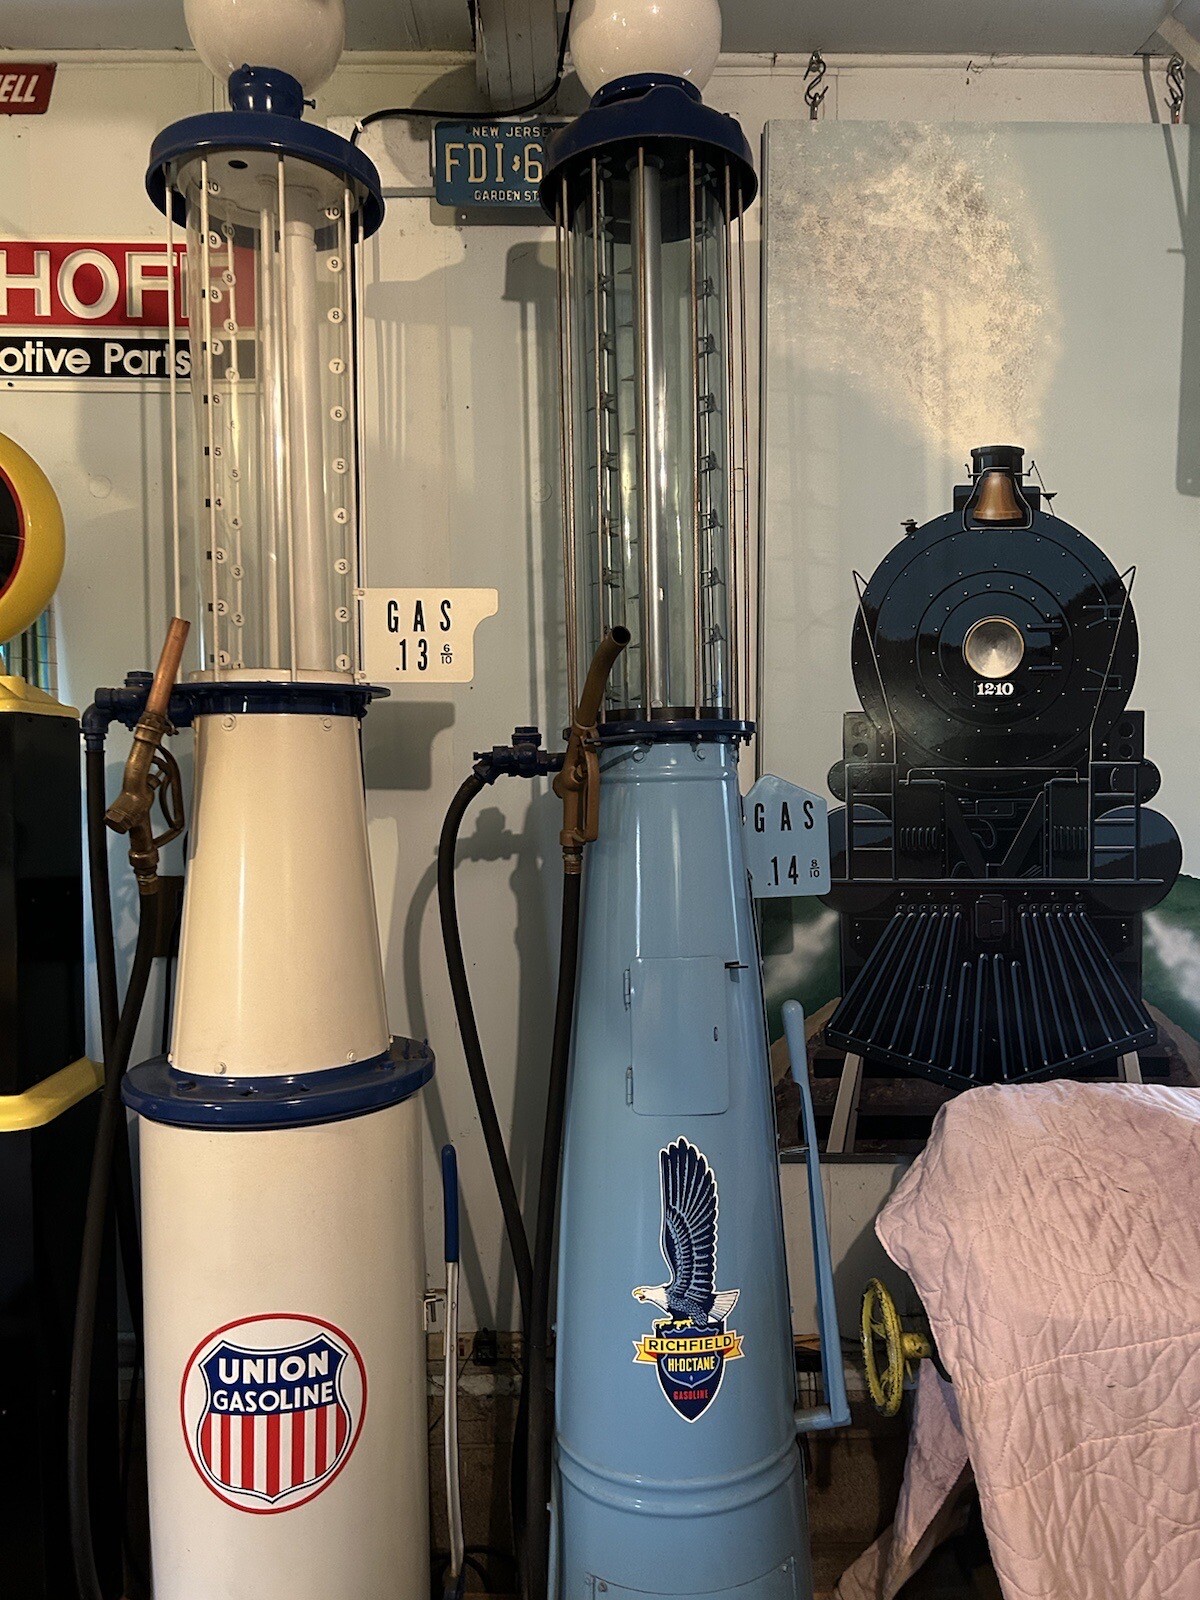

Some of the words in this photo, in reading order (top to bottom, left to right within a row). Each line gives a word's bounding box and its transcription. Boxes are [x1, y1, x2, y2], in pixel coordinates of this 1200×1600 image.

[0, 74, 40, 103] ELL
[472, 126, 499, 137] NEW
[474, 190, 520, 201] GARDEN
[327, 207, 340, 216] 10
[210, 235, 217, 245] 9
[331, 260, 338, 269] 9
[226, 274, 233, 283] 9
[211, 290, 219, 299] 8
[332, 311, 340, 320] 8
[228, 322, 235, 331] 8
[213, 343, 219, 352] 7
[333, 362, 340, 371] 7
[229, 371, 236, 380] 7
[213, 395, 220, 404] 6
[334, 409, 342, 418] 6
[214, 448, 222, 456] 5
[337, 461, 344, 470] 5
[232, 469, 239, 478] 5
[215, 499, 222, 507] 4
[337, 512, 345, 520] 4
[232, 518, 239, 526] 4
[216, 551, 223, 560] 3
[339, 562, 346, 571] 3
[234, 567, 241, 576] 3
[217, 603, 225, 612] 2
[236, 614, 242, 623] 2
[340, 610, 347, 618] 2
[387, 599, 452, 633] GAS
[340, 658, 346, 667] 1
[754, 800, 814, 833] GAS
[648, 1335, 733, 1351] RICHFIELD
[218, 1350, 329, 1385] UNION
[213, 1380, 334, 1413] GASOLINE
[673, 1389, 709, 1401] GASOLINE
